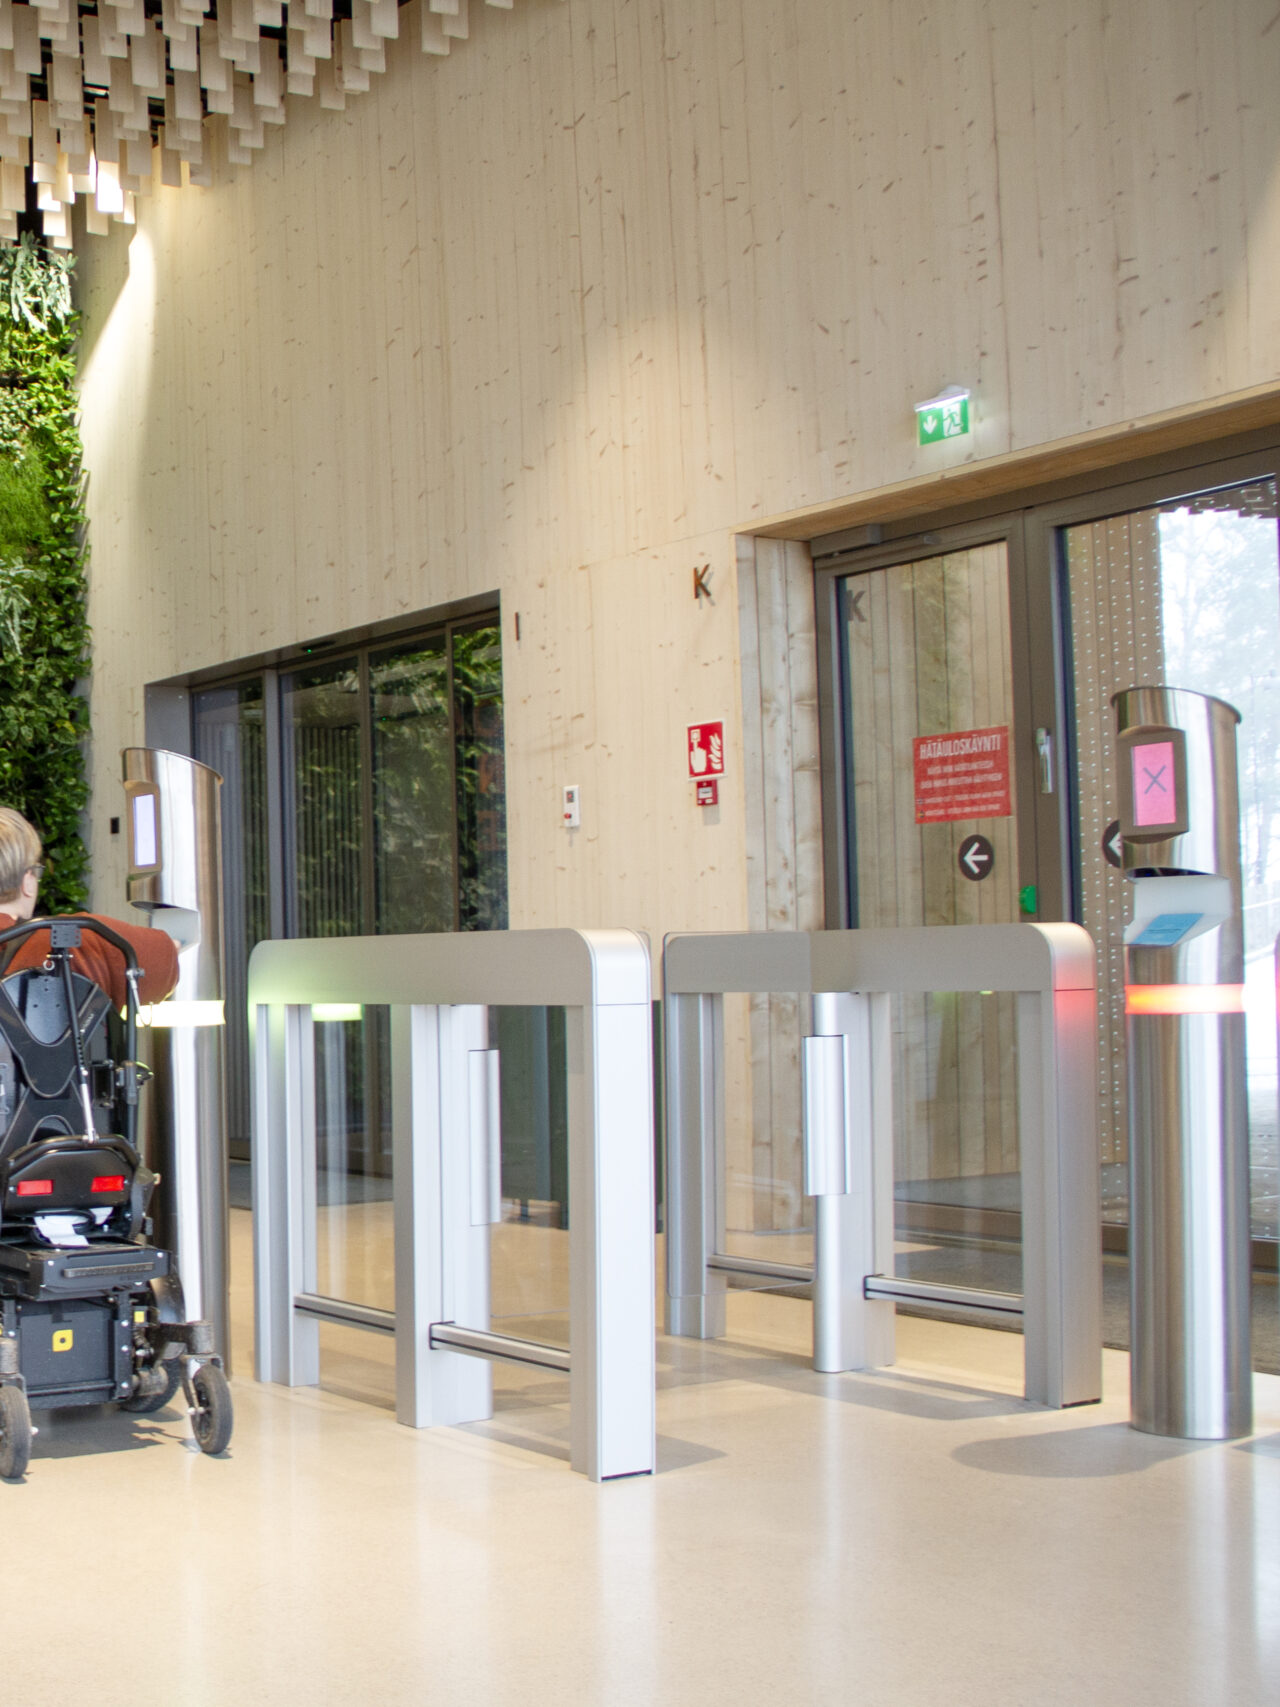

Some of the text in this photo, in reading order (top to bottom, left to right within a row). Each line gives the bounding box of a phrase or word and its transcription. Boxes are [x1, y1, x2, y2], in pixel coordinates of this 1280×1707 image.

[693, 563, 711, 600] K
[844, 590, 867, 622] K
[919, 734, 1001, 760] HÄTÄULOSKÄYNTI
